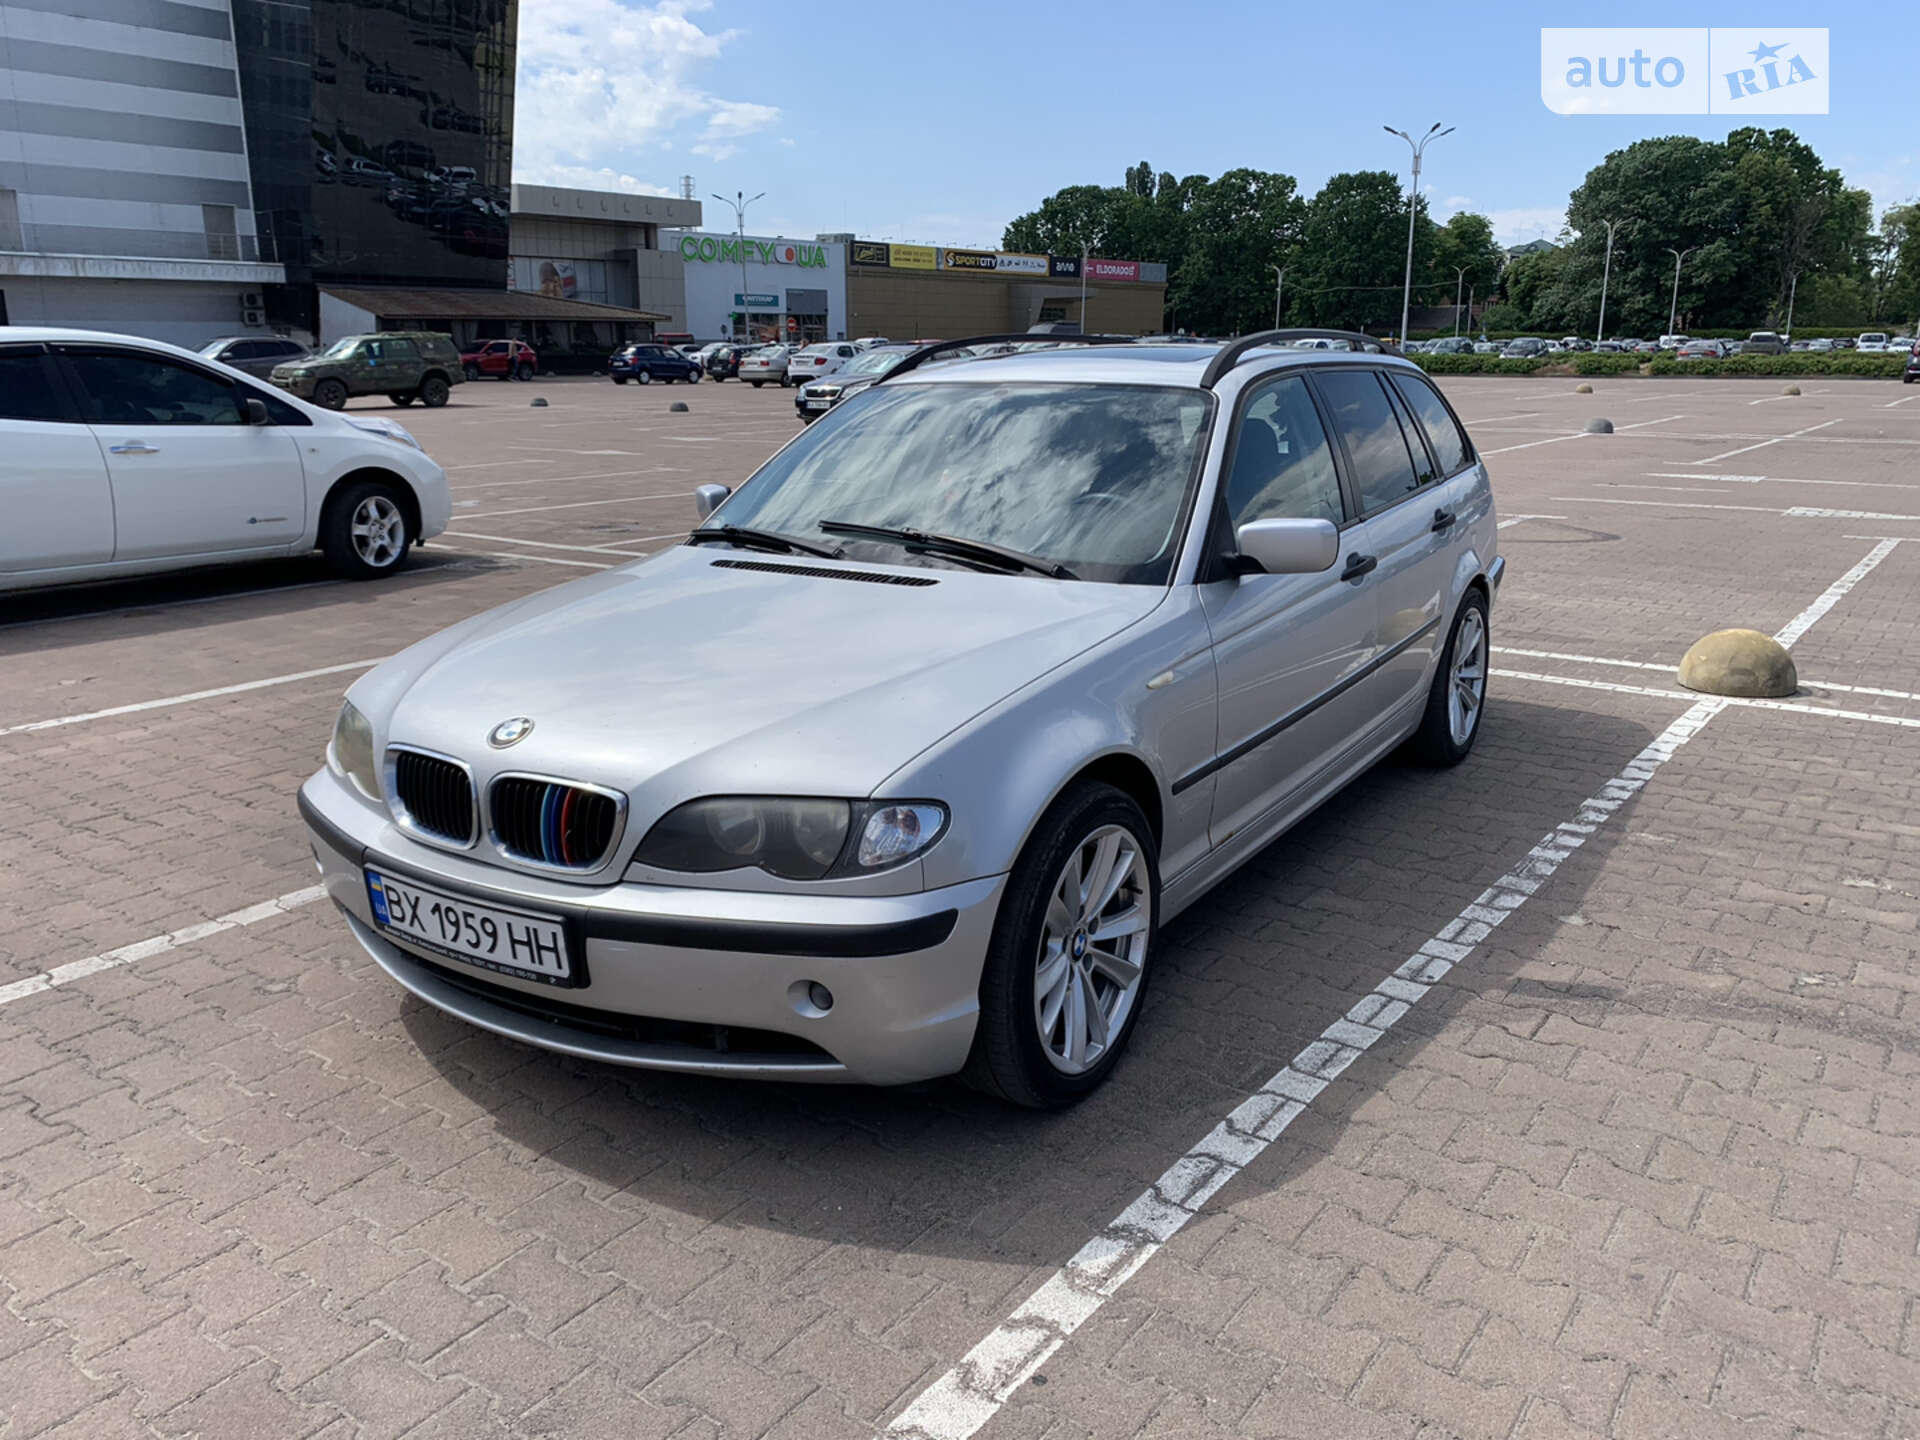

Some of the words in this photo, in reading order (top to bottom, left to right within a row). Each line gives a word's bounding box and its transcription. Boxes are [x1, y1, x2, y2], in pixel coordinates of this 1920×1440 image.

[383, 884, 426, 932] BX
[430, 902, 498, 954] 1959
[506, 921, 563, 970] HH
